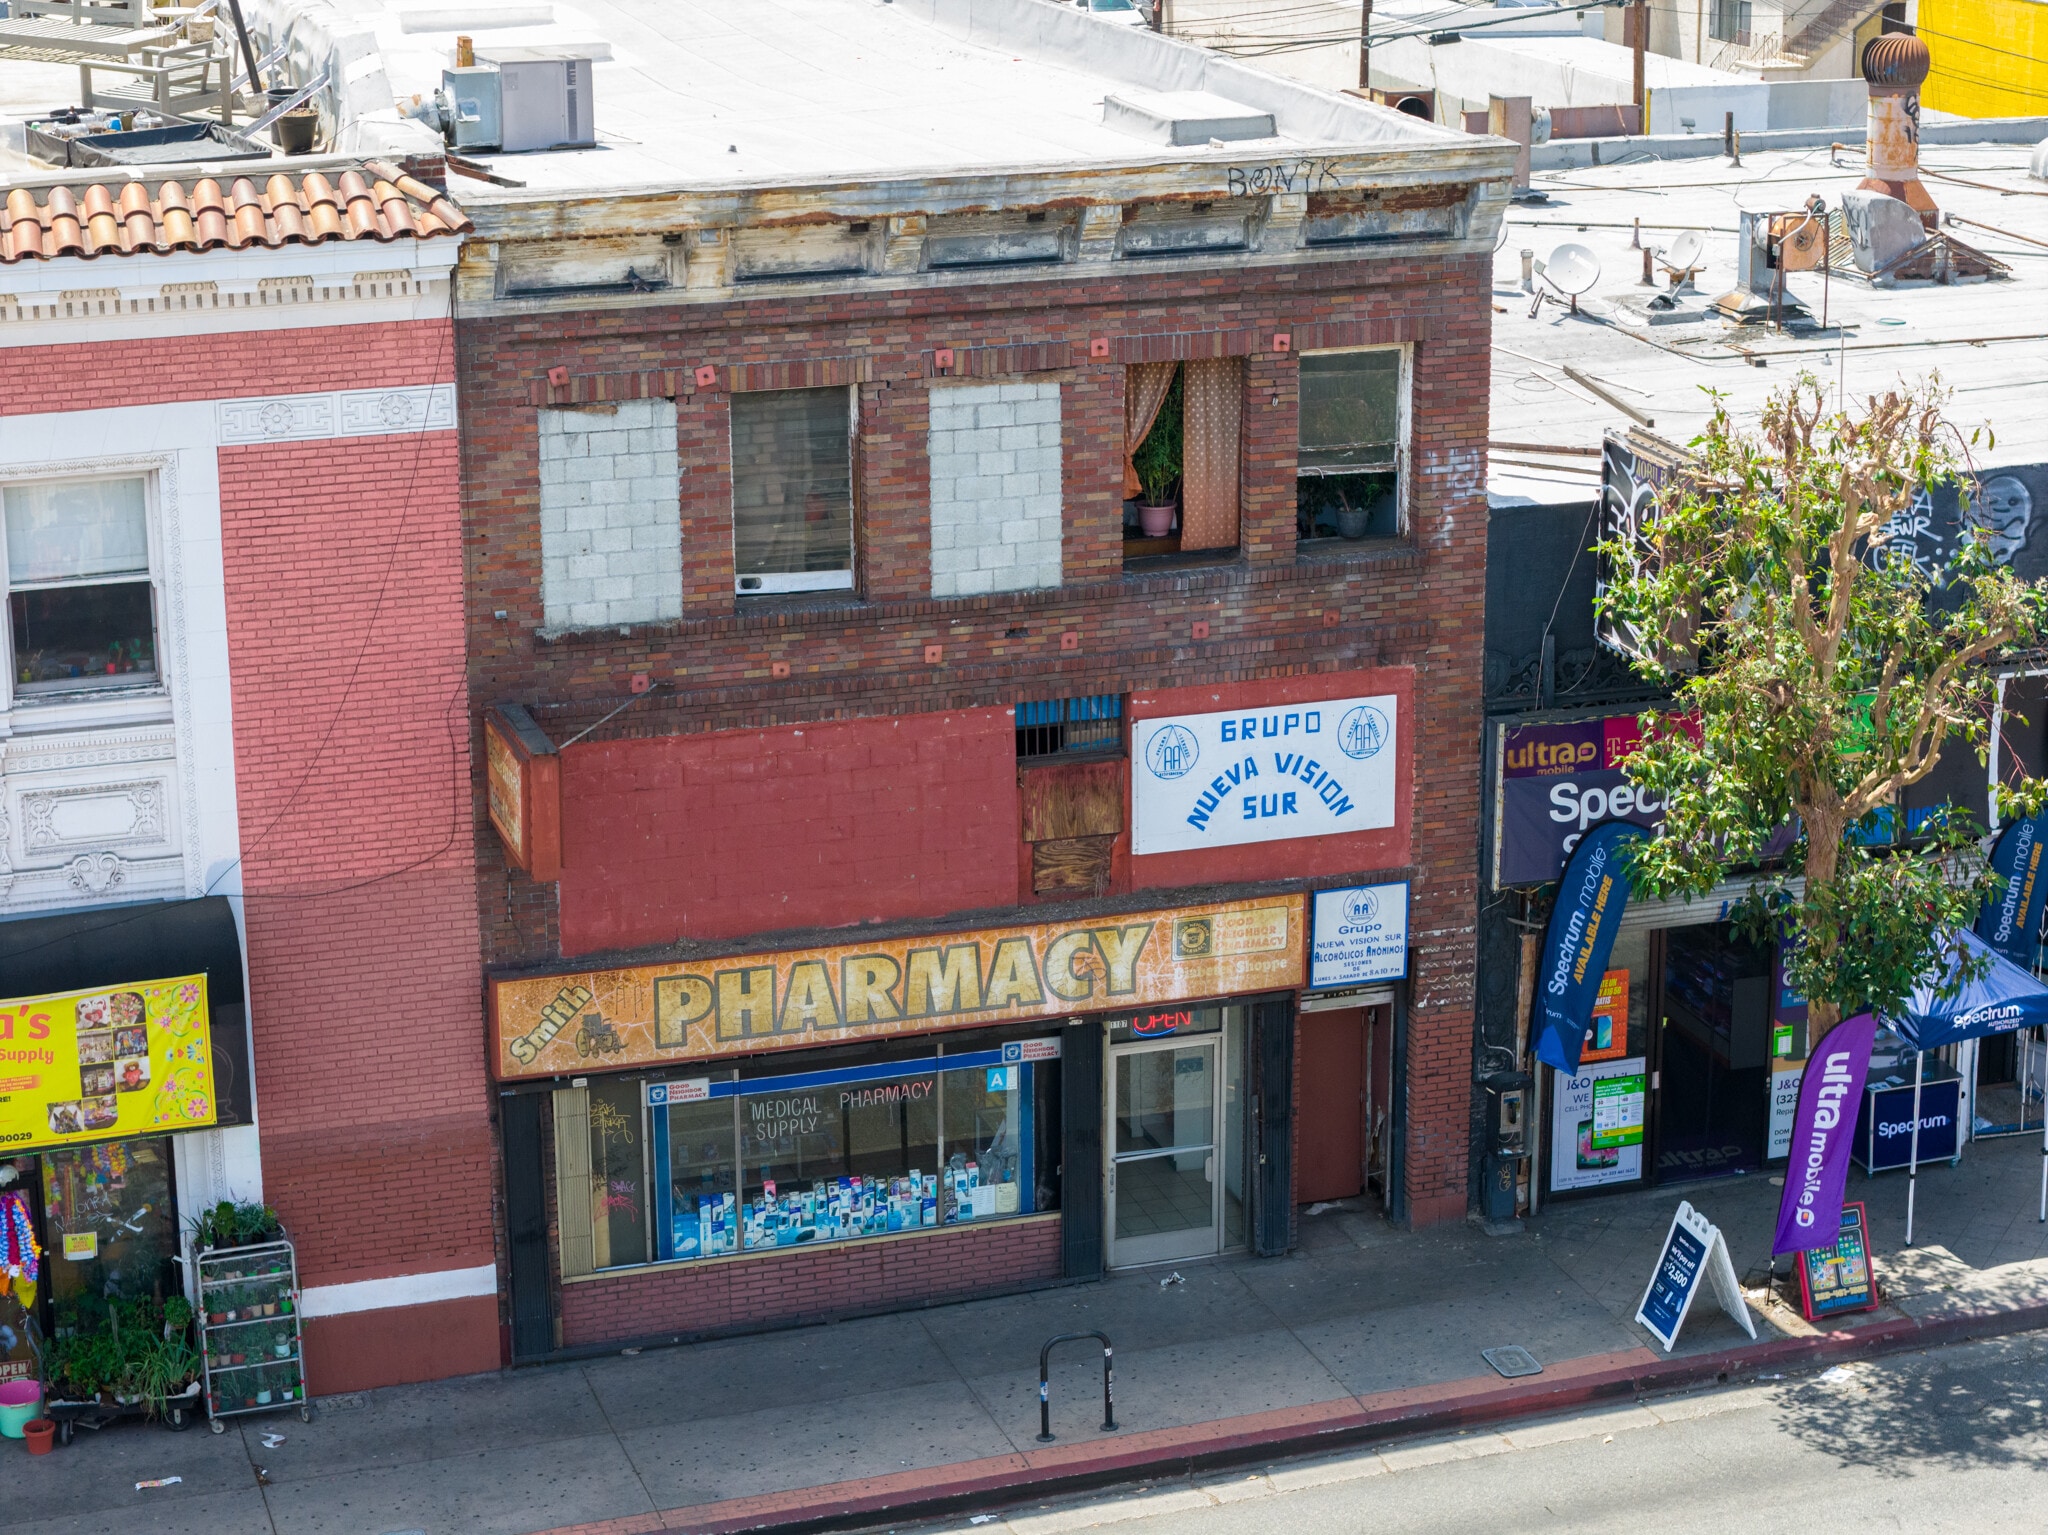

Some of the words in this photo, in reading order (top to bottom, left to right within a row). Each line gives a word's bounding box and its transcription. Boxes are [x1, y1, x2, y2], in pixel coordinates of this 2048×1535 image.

[1221, 711, 1321, 742] GRUPO
[1507, 741, 1576, 769] ultra
[1537, 763, 1575, 775] mobile
[1187, 756, 1260, 831] NUEVA
[1274, 752, 1354, 817] VISION
[1243, 791, 1299, 820] SUR
[1994, 875, 2022, 943] Spectrum
[2013, 823, 2034, 871] mobile
[2015, 872, 2036, 930] AVAILABLE
[2028, 841, 2044, 874] HERE
[1353, 903, 1369, 915] AA
[1547, 910, 1586, 996] Spectrum
[1579, 847, 1607, 908] mobile
[1316, 941, 1345, 950] NUEVA
[1350, 936, 1380, 946] VISION
[1385, 933, 1402, 941] SUR
[1338, 923, 1382, 935] Grupo
[1573, 912, 1601, 985] AVAILABLE
[1595, 874, 1614, 913] HERE
[653, 922, 1155, 1050] PHARMACY
[510, 985, 594, 1065] Smith
[1133, 1010, 1192, 1031] OPEN
[1953, 1004, 2020, 1030] Spectrum
[1994, 1023, 2020, 1032] RETAILER
[1023, 1051, 1059, 1059] PHARMACY
[669, 1087, 702, 1096] NEIGHBOR
[990, 1072, 1004, 1087] A
[1566, 1077, 1591, 1091] J&O
[1813, 1052, 1853, 1130] ultra
[669, 1092, 707, 1101] PHARMACY
[840, 1080, 933, 1110] PHARMACY
[1573, 1092, 1590, 1104] WE
[752, 1096, 822, 1121] MEDICAL
[1564, 1104, 1579, 1113] CELL
[0, 1132, 33, 1142] 90029
[756, 1116, 817, 1141] SUPPLY
[1774, 1128, 1790, 1137] DOM
[1878, 1114, 1947, 1139] Specrum
[1798, 1131, 1827, 1206] mobile
[0, 1362, 27, 1376] PEN
